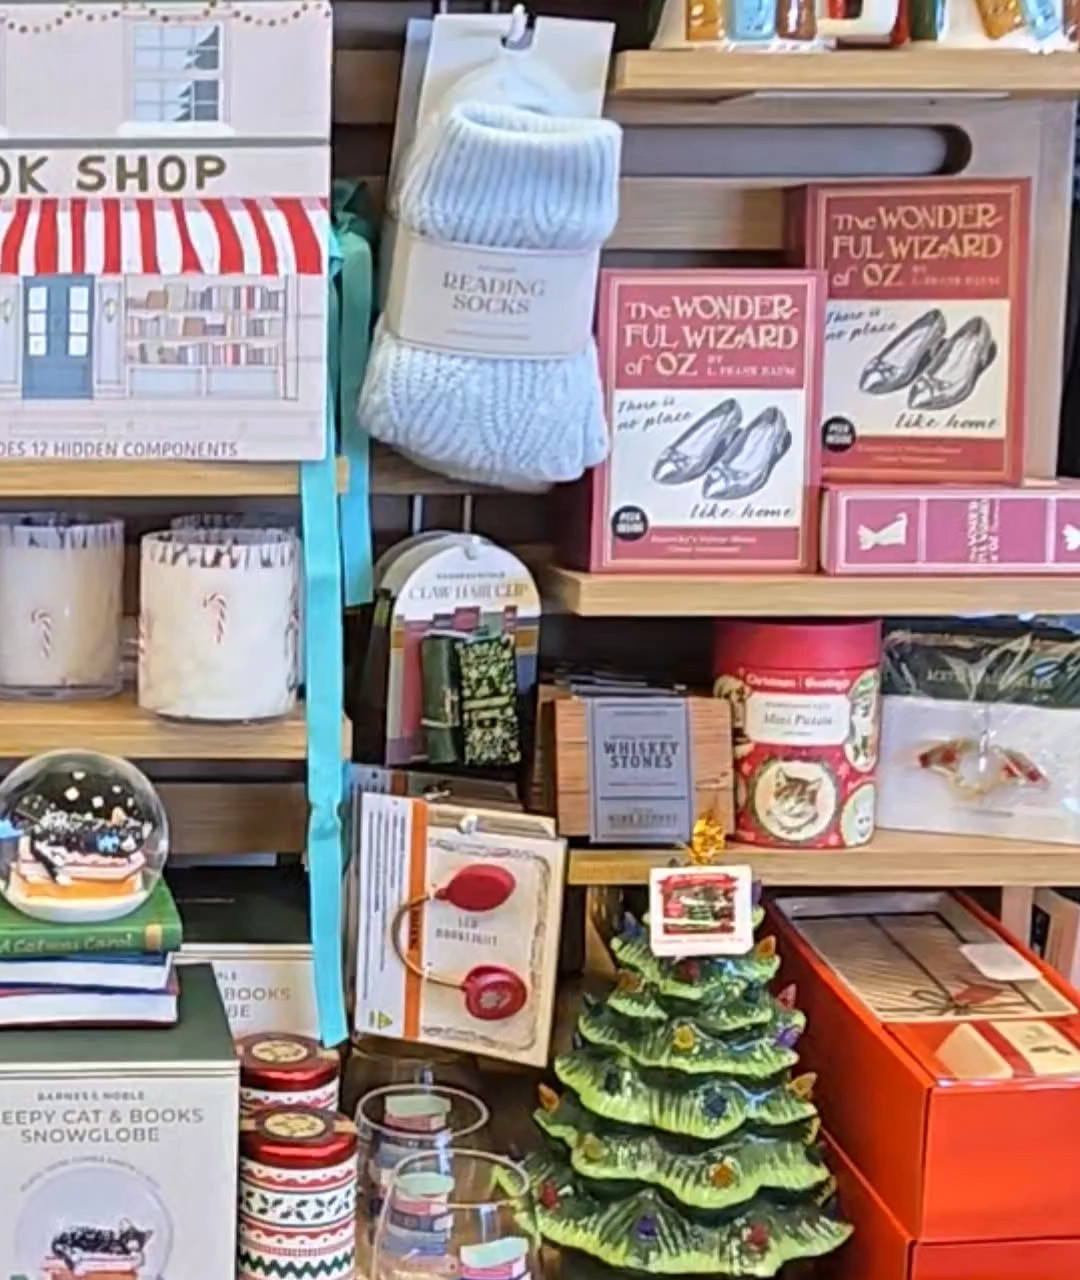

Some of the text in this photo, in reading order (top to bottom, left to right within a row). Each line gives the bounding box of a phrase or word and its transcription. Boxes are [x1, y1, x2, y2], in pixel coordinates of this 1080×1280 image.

[76, 154, 228, 193] SHOP
[833, 213, 876, 231] The
[832, 233, 1003, 260] FUL WIZARD
[443, 271, 546, 296] READING
[832, 264, 903, 288] of OZ
[452, 294, 530, 315] SOCKS
[625, 302, 672, 319] The
[624, 324, 798, 349] FUL WIZARD
[625, 351, 699, 376] of OZ
[31, 440, 48, 457] 12
[54, 440, 119, 457] HIDDEN
[123, 440, 238, 457] COMPONENTS
[409, 585, 451, 600] CLAW
[603, 741, 680, 755] WHISKEY
[609, 754, 673, 769] STONES
[37, 1091, 89, 1102] BARNES
[103, 1090, 146, 1101] NOBLE
[62, 1109, 103, 1125] CAT
[108, 1109, 123, 1125] &
[130, 1108, 205, 1124] BOOKS
[20, 1126, 161, 1144] SNOWGLOBE
